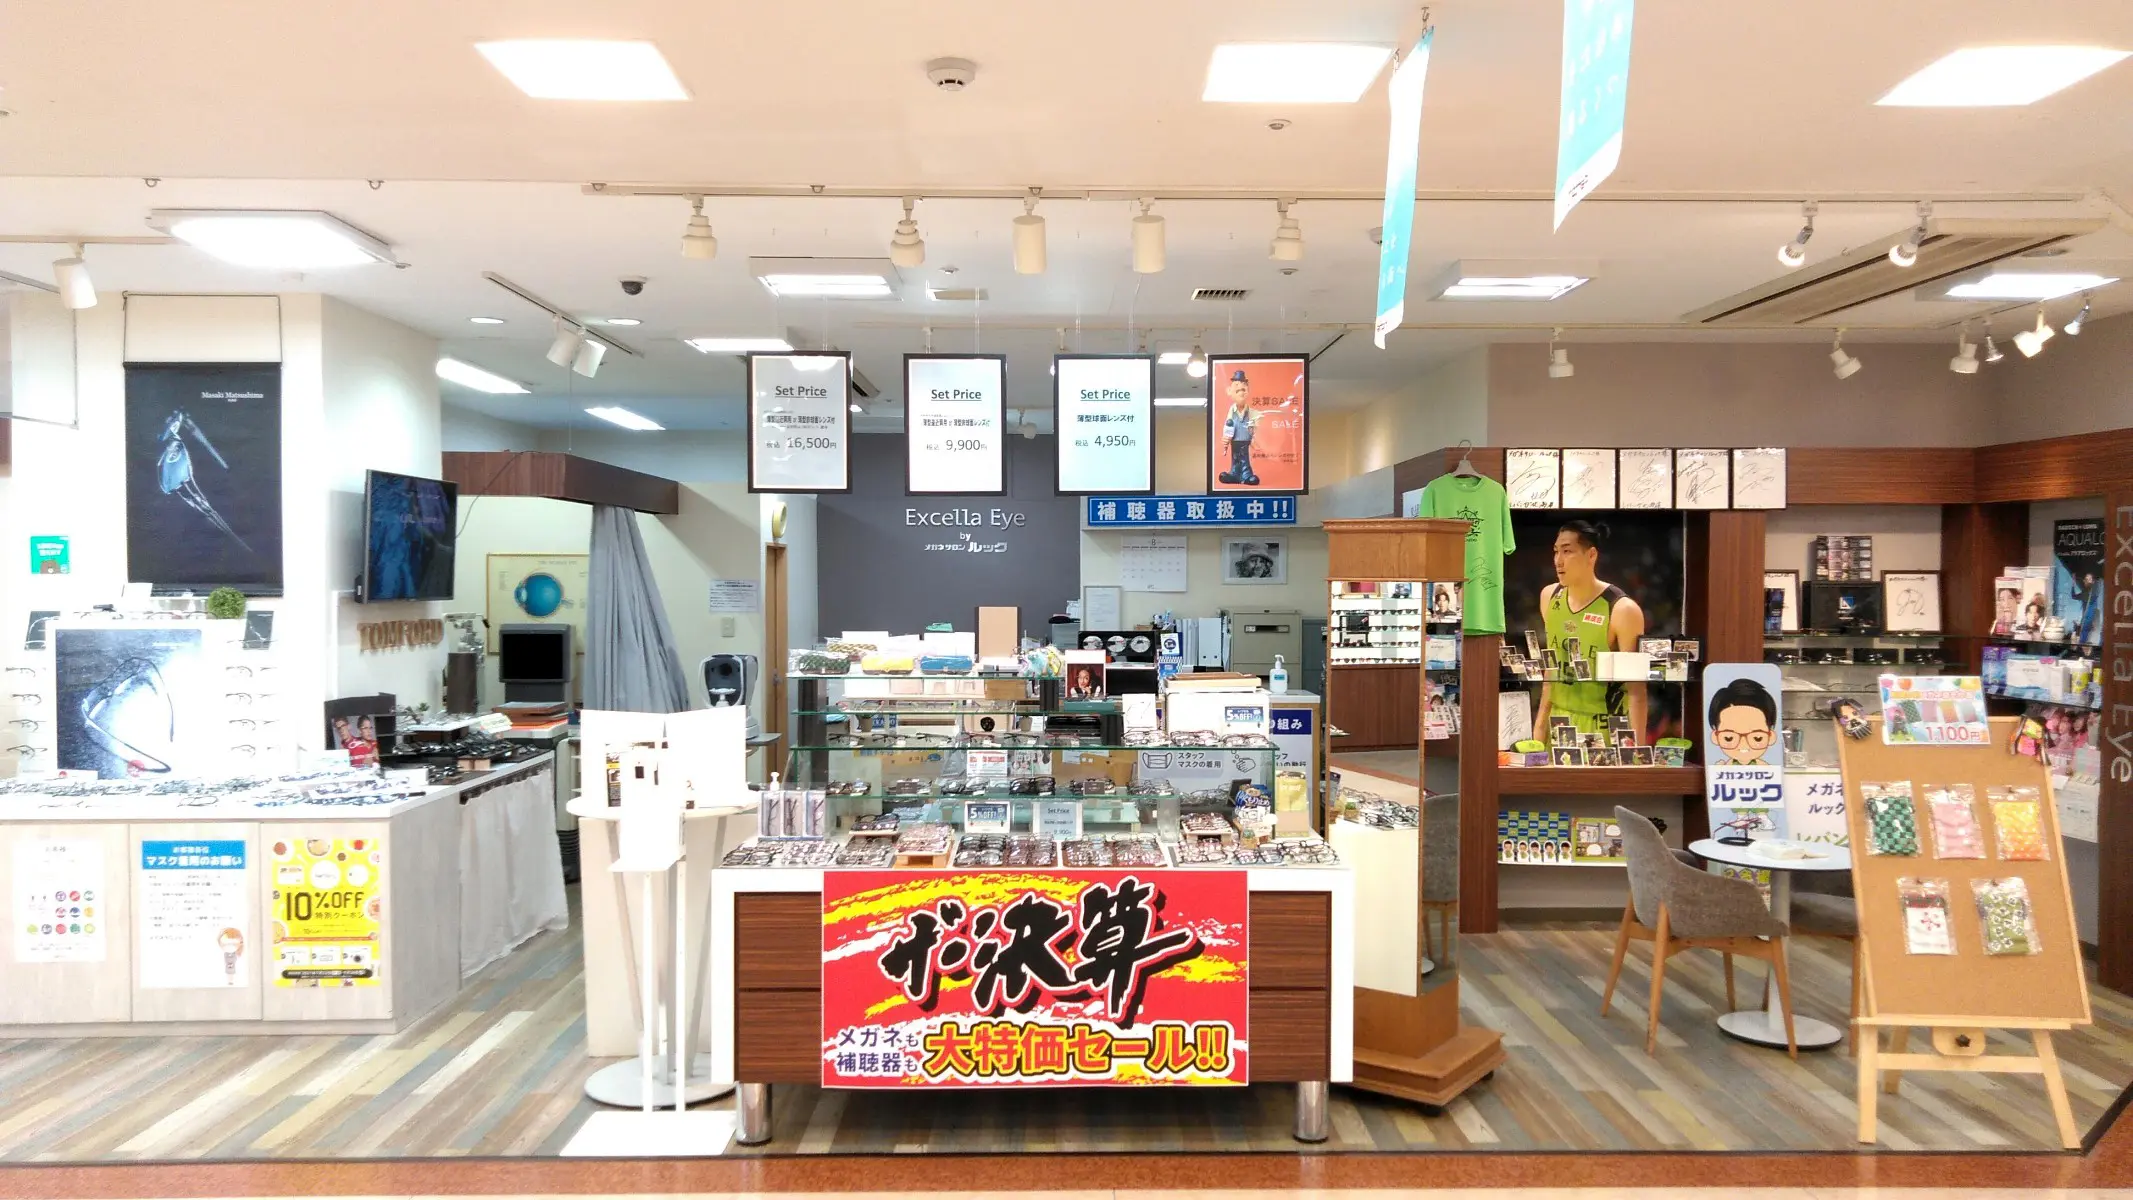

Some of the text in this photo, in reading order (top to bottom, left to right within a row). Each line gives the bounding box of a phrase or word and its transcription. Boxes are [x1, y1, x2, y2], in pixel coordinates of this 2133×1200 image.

[775, 386, 827, 397] Set Price
[931, 389, 982, 400] Set Price
[1080, 389, 1131, 400] Set Price
[1077, 414, 1135, 423] 薄型球面レンズ付
[1271, 420, 1299, 428] SALE
[945, 439, 988, 452] 9,900円
[1075, 435, 1136, 448] 税込 4,950円
[1097, 501, 1288, 521] 補聴器取扱中!!
[905, 508, 1026, 531] Excella Eye
[959, 532, 972, 541] by
[967, 541, 1008, 552] ルック
[1715, 771, 1774, 780] メガネサロン
[1711, 783, 1783, 802] ルック
[146, 855, 242, 867] マスク着用のお願い
[314, 911, 365, 919] 特別クーポン
[838, 1027, 919, 1049] メガネも
[924, 1022, 1229, 1077] 大特価セール!!
[836, 1052, 919, 1073] 補聴器も
